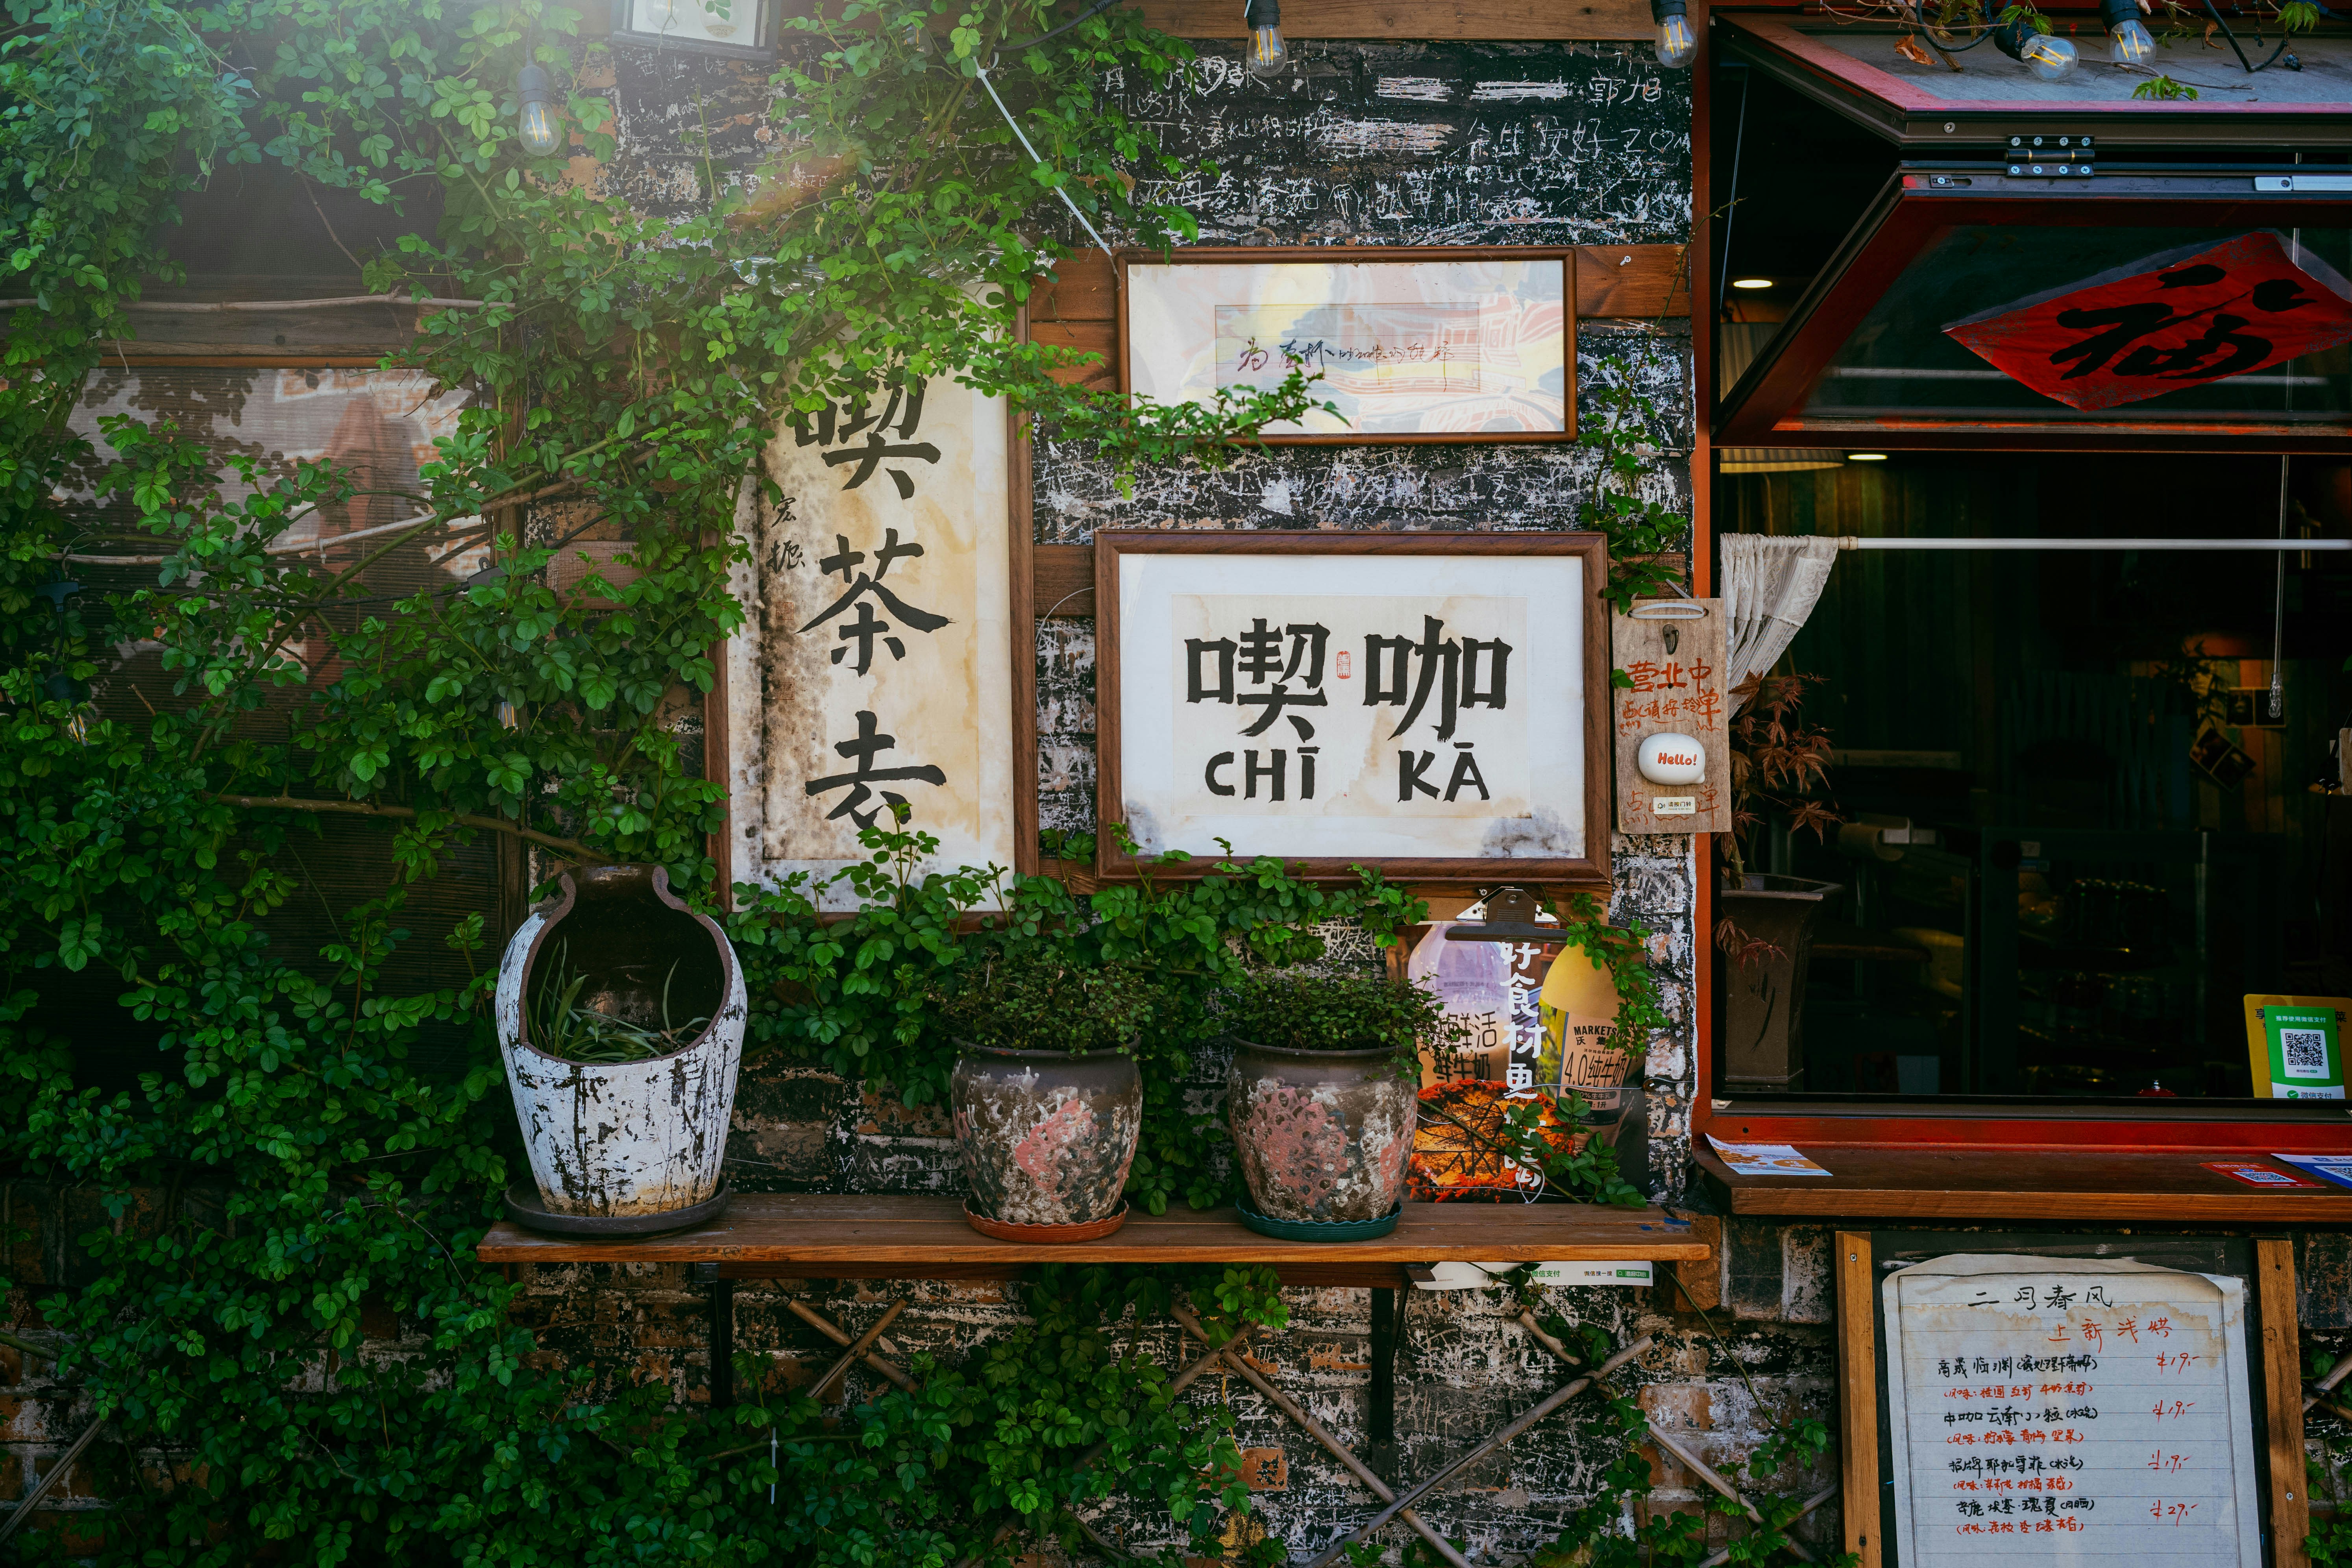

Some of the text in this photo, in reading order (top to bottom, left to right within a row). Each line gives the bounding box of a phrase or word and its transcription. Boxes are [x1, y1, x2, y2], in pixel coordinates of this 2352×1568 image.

[2049, 264, 2317, 380] 福
[1626, 658, 1711, 696] 营业中
[1205, 742, 1490, 803] CHĪ KĀ
[1658, 752, 1697, 766] Hello!
[1437, 1010, 1497, 1048] 鲜活
[1574, 1025, 1627, 1039] MARKETS
